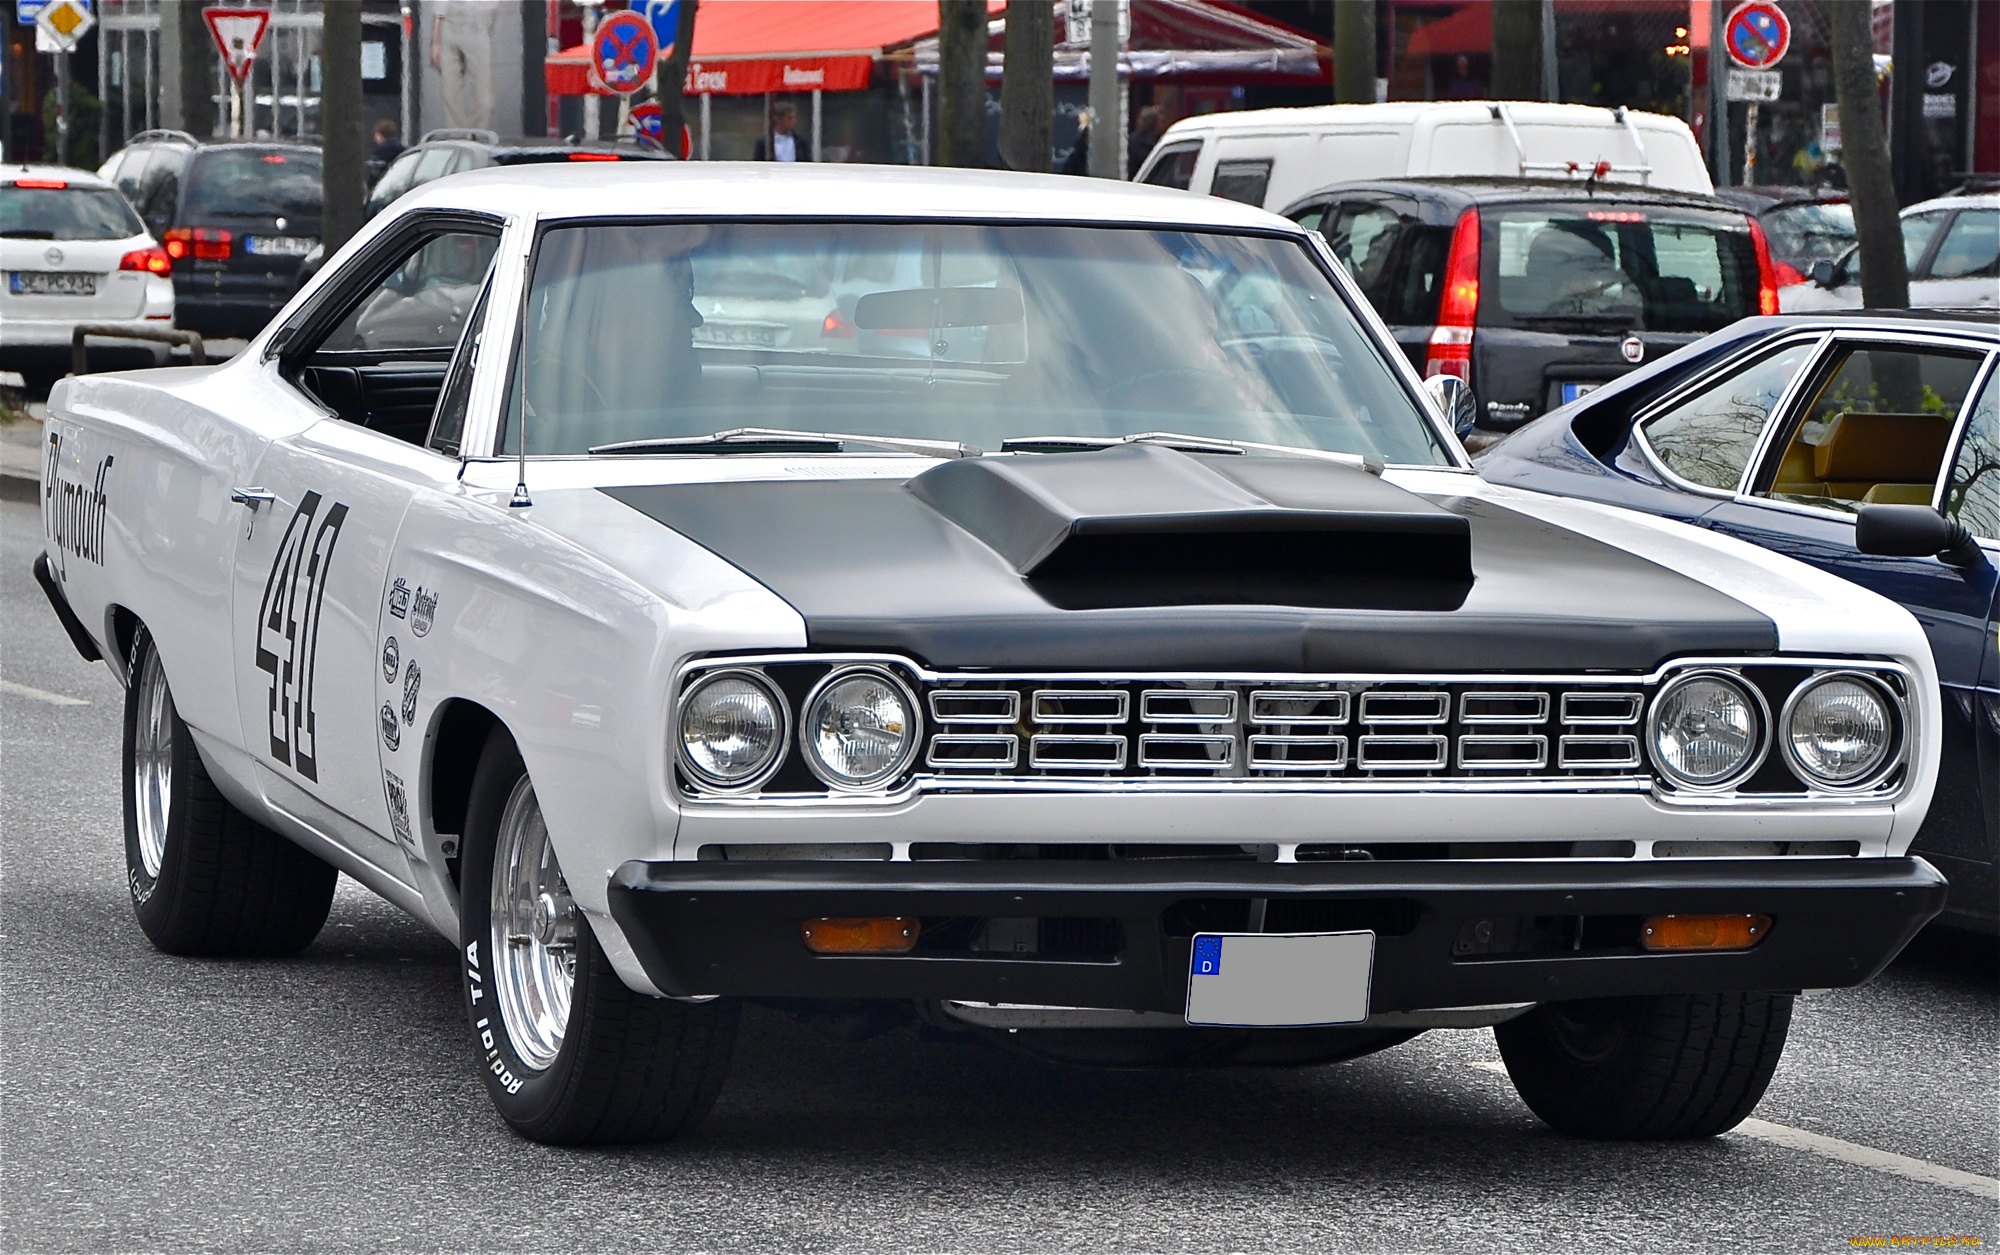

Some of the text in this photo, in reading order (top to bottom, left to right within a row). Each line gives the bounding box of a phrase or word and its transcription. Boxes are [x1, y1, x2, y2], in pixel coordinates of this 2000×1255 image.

[46, 432, 113, 583] Plymouth
[256, 490, 349, 784] 41
[466, 940, 524, 1094] Radial T/A
[1202, 960, 1212, 973] D
